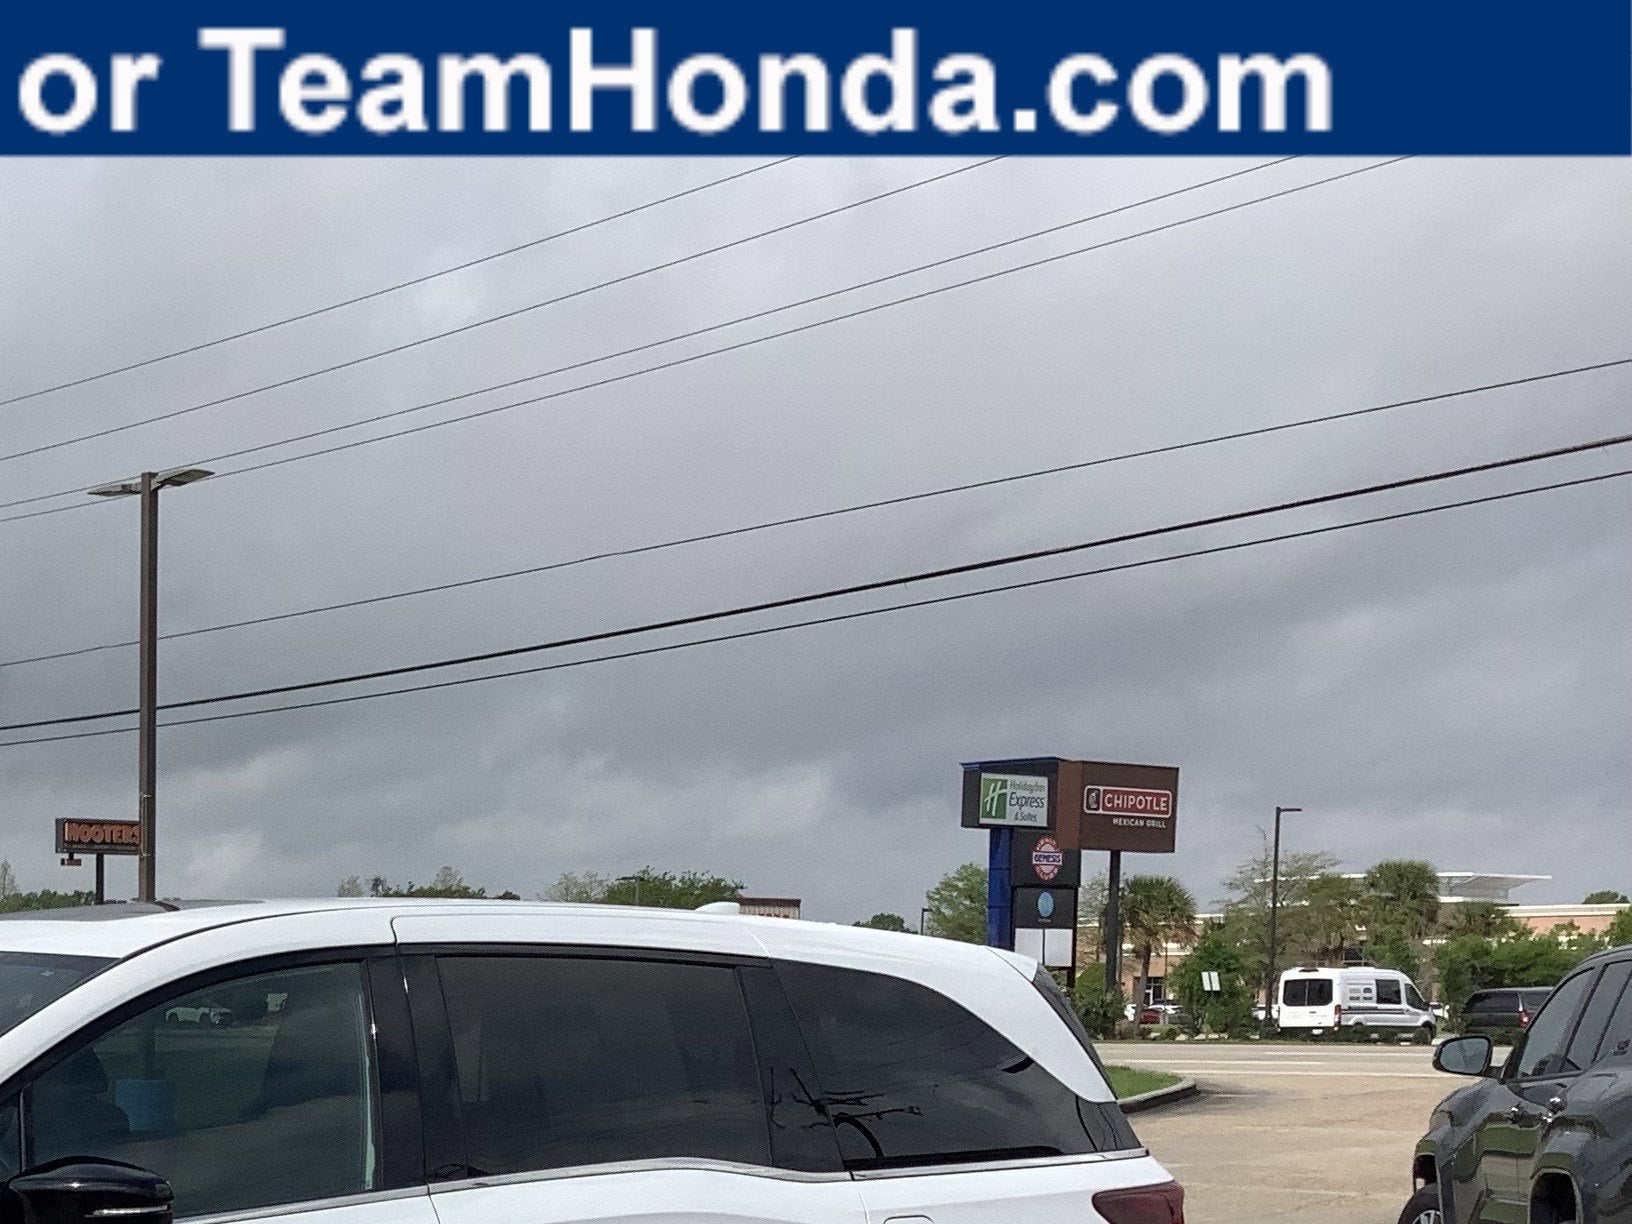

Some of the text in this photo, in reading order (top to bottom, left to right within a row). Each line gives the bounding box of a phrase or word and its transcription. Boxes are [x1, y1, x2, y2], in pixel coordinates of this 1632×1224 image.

[1009, 792, 1045, 810] Express
[1104, 793, 1168, 811] CHIPOTLE
[1021, 813, 1038, 823] Suites
[1112, 817, 1167, 829] MEXICAN GRILL
[1033, 853, 1060, 863] GENESIS
